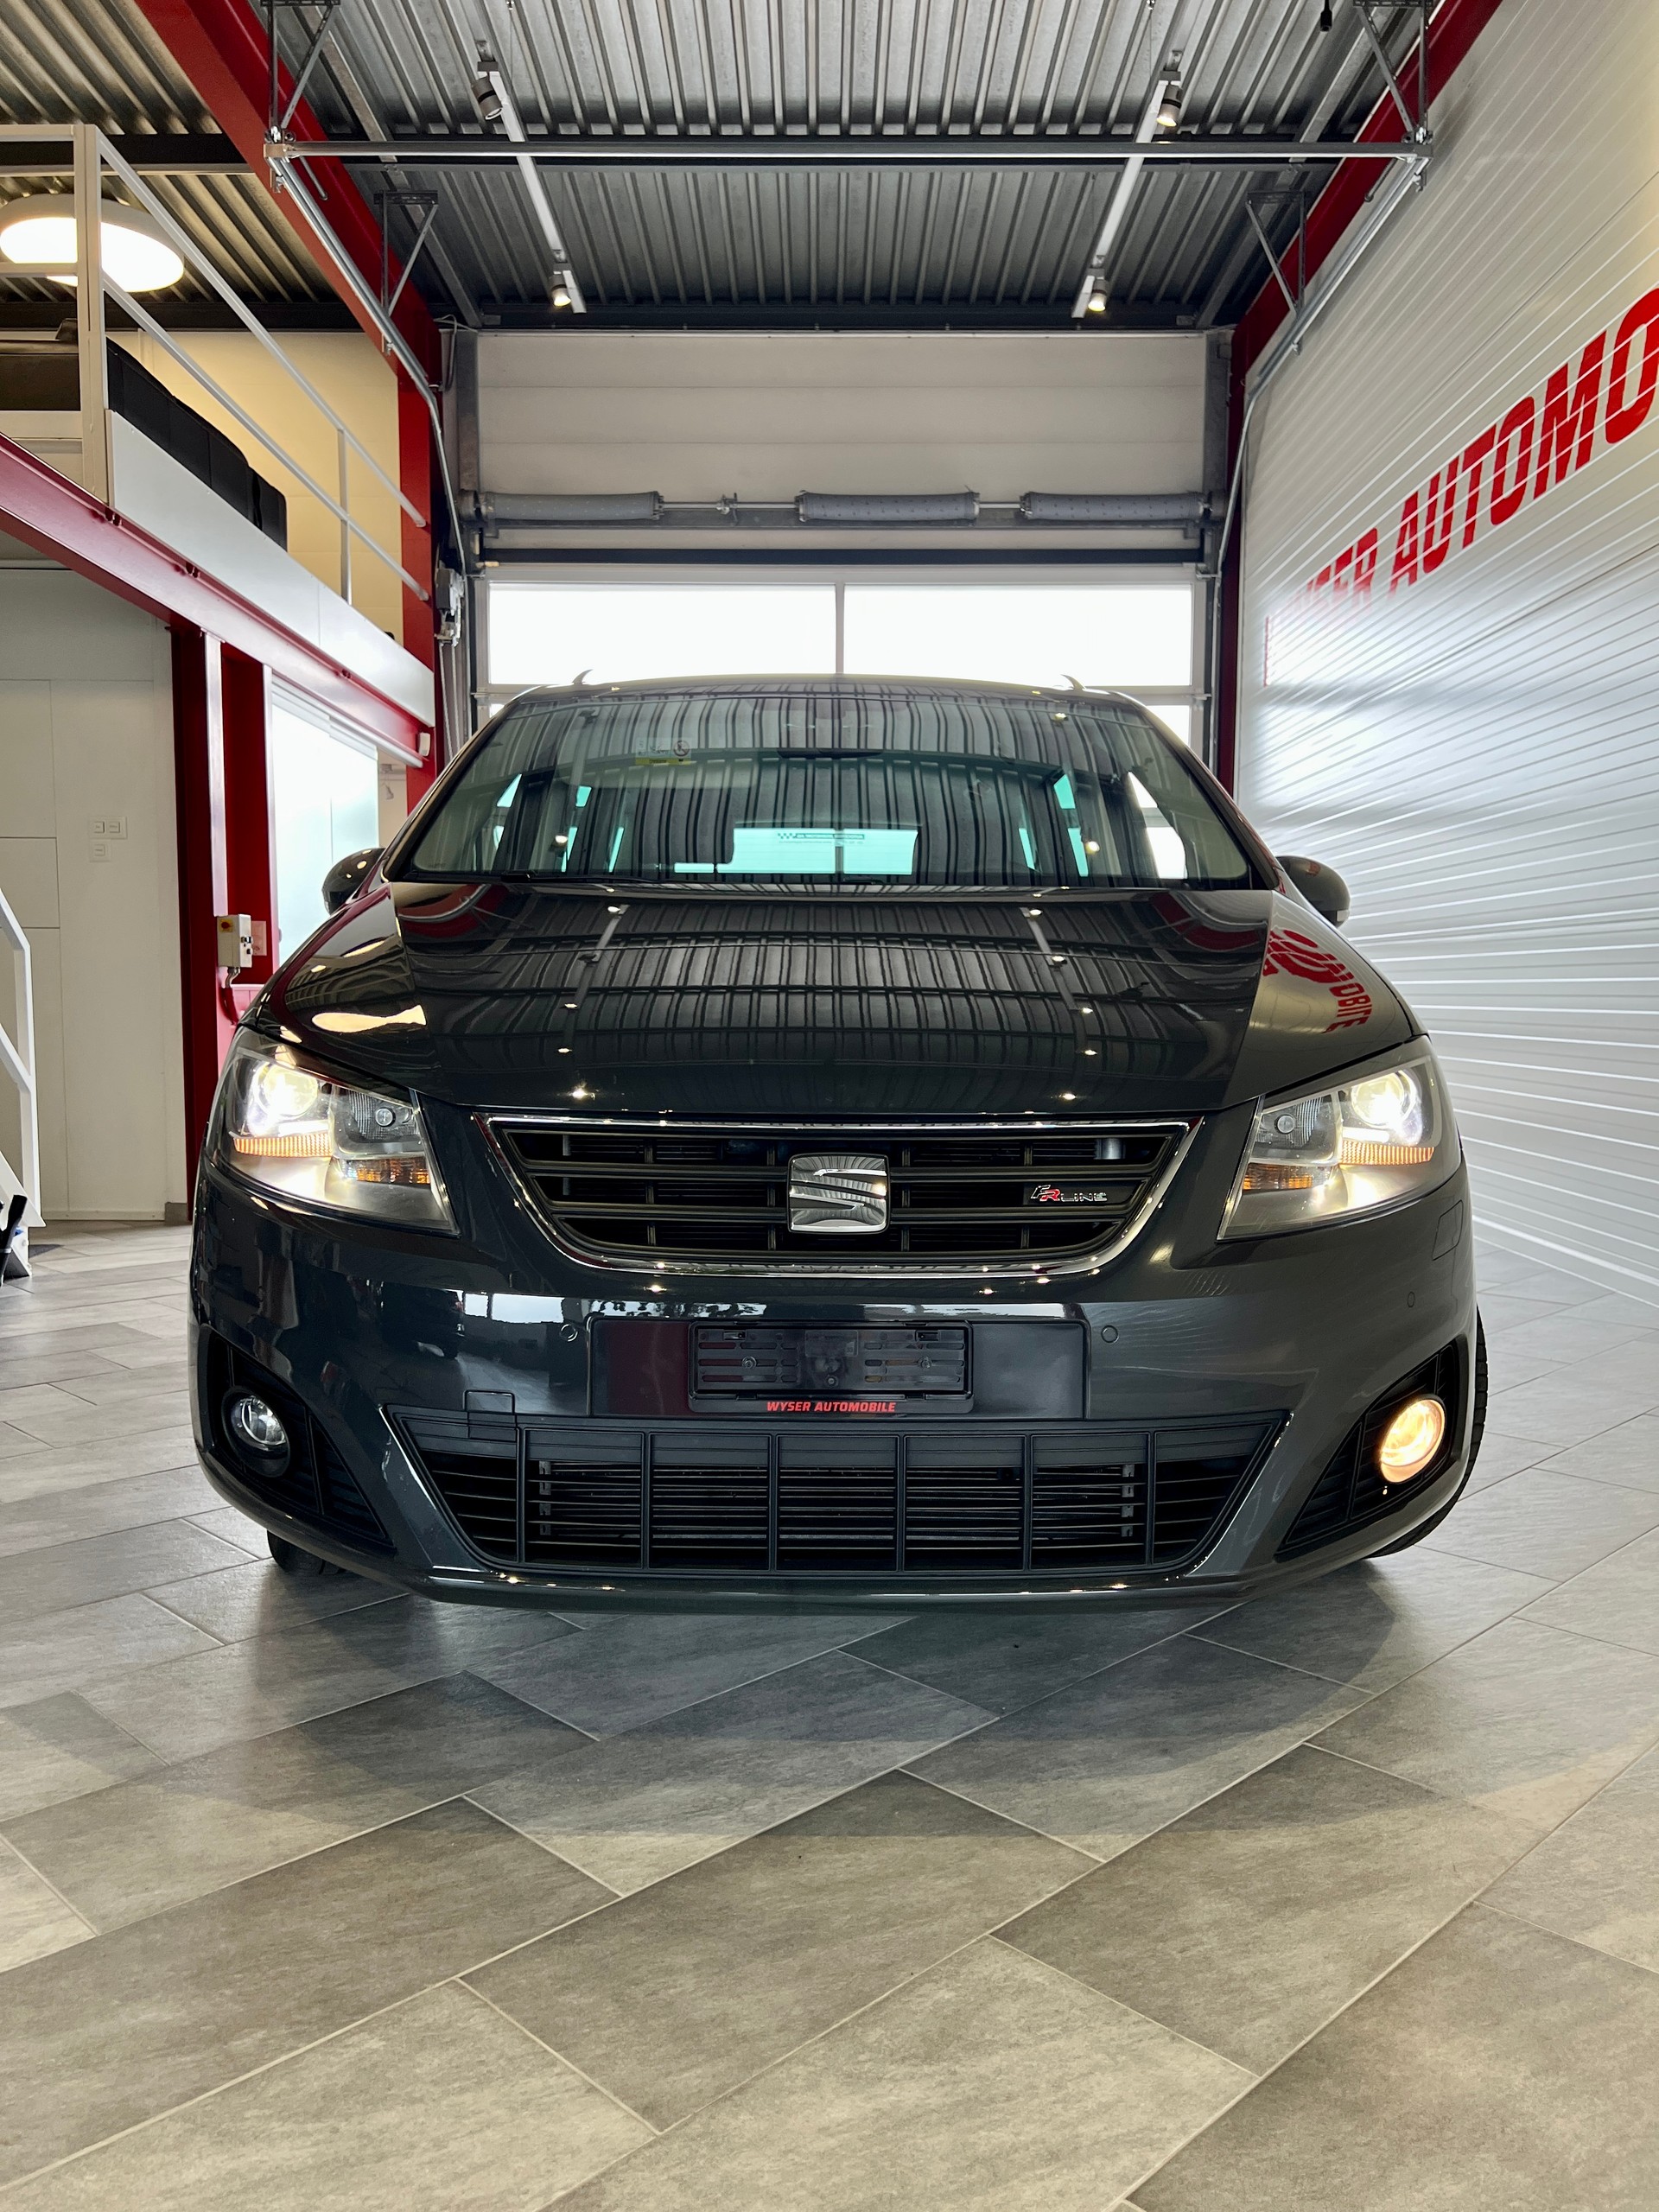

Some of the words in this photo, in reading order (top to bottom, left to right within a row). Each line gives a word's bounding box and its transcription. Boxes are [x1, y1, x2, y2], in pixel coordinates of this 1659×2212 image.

[1387, 288, 1659, 598] AUTOMO
[766, 1401, 811, 1412] WYSER
[813, 1401, 897, 1412] AUTOMOBILE
